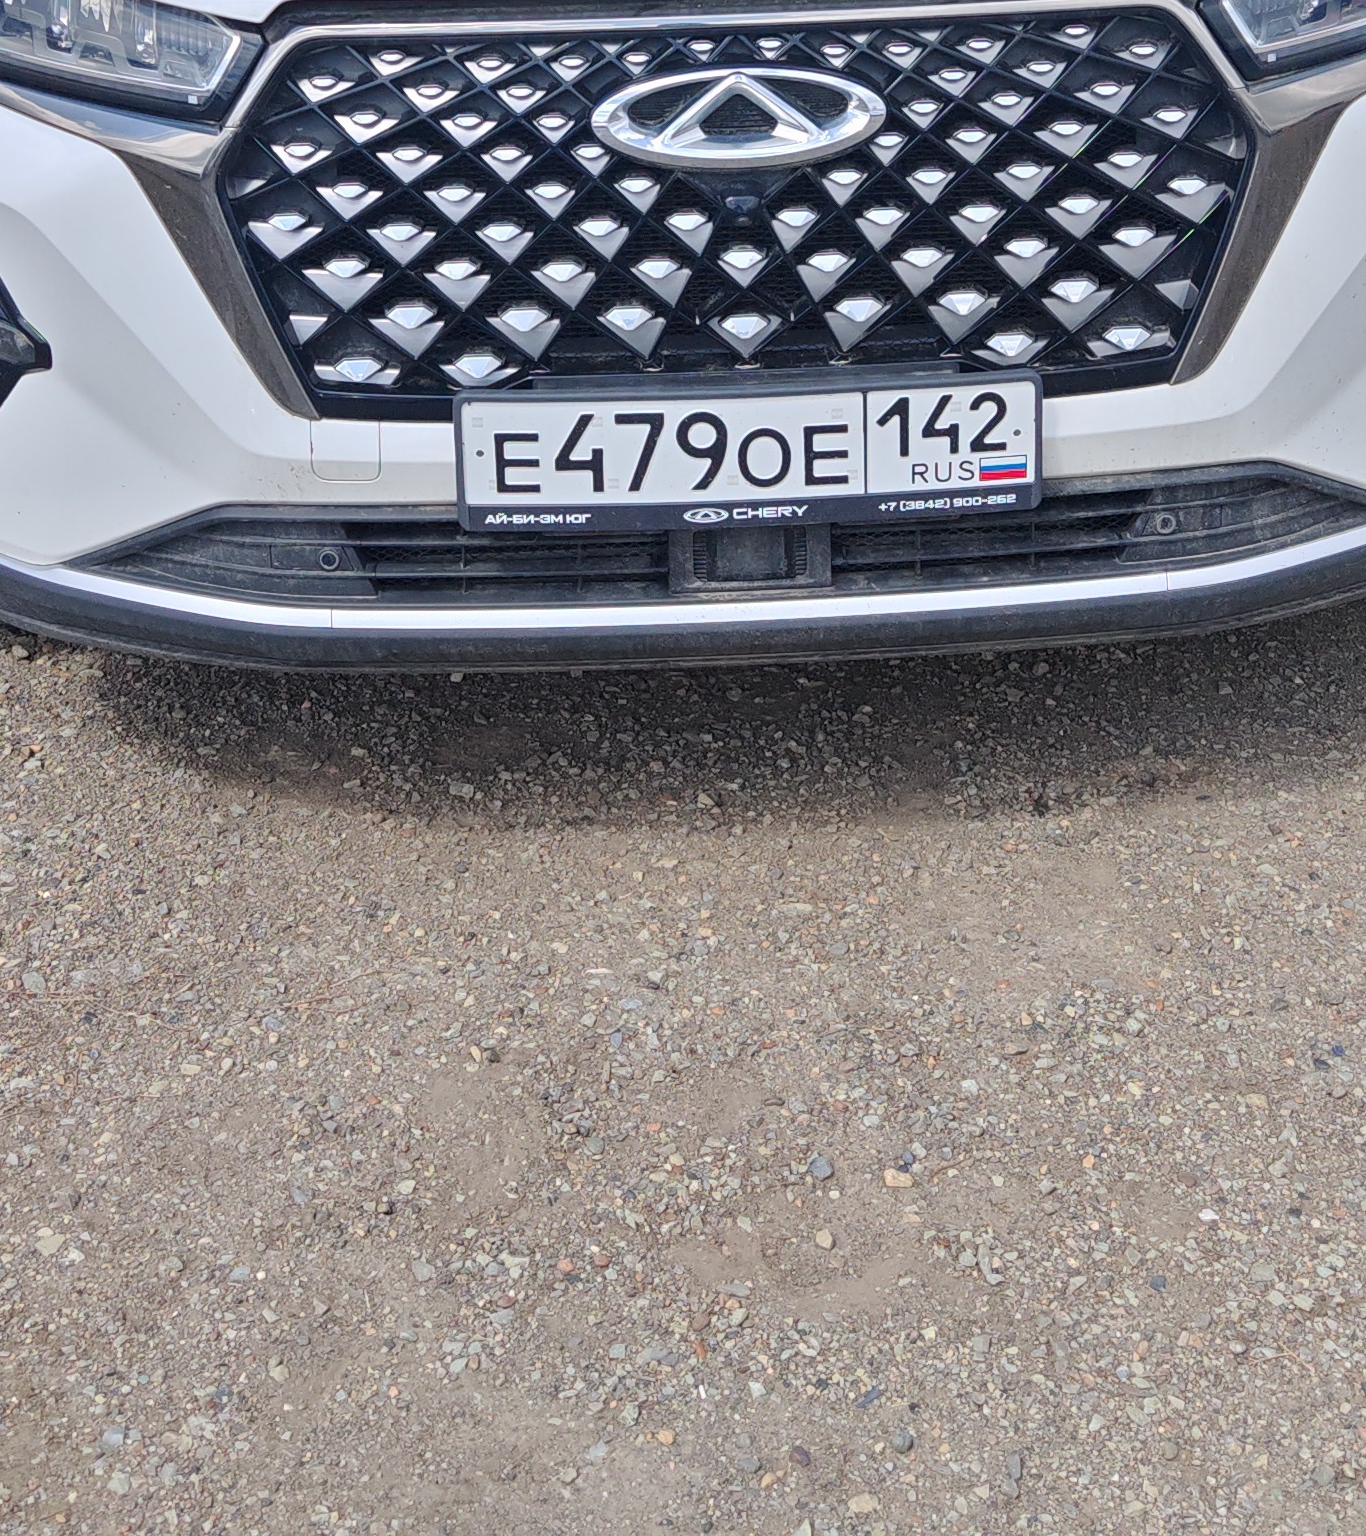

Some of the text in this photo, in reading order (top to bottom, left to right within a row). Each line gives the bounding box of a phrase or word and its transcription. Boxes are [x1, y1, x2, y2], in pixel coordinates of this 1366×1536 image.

[493, 391, 1008, 494] Е479ОЕ 142
[911, 460, 975, 485] RUS
[878, 501, 898, 512] +7
[952, 493, 1018, 508] 900-262
[484, 512, 592, 525] АЙ-БИ-ЭМ ЮГ
[732, 505, 809, 520] CHERY
